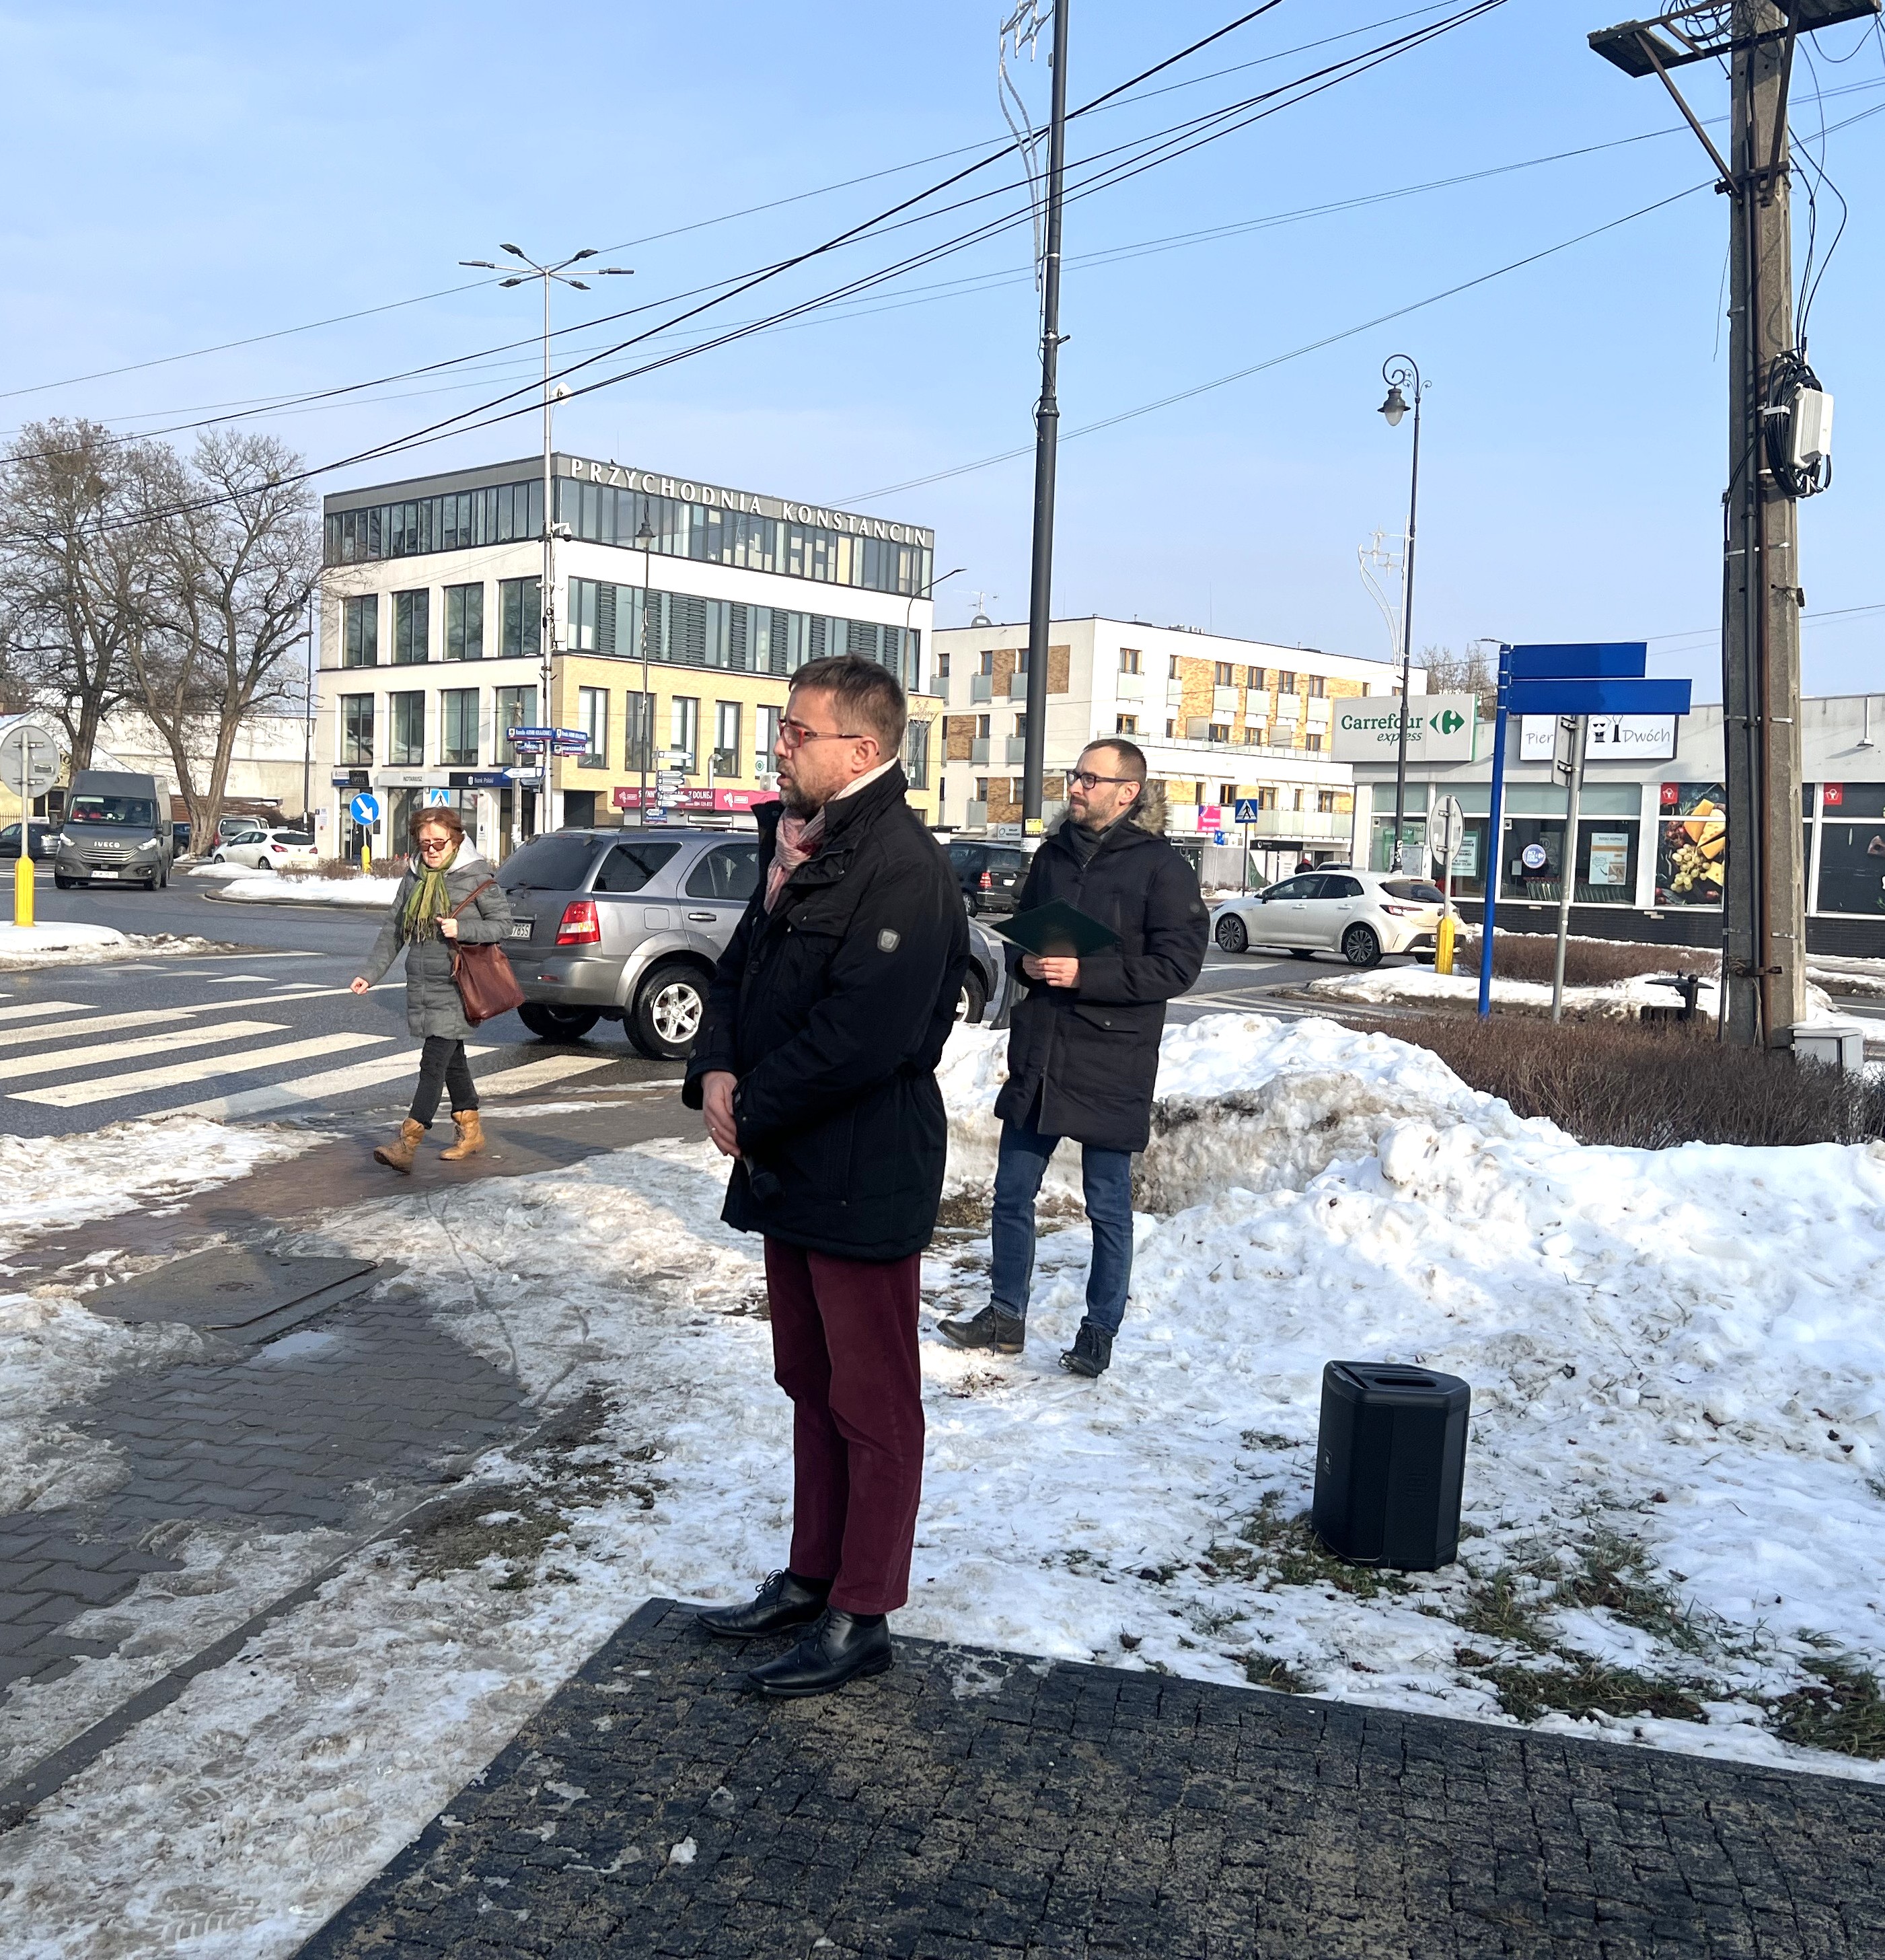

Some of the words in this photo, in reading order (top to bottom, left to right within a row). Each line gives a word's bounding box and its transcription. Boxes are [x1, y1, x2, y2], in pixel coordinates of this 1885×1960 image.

[572, 458, 761, 514] PRZYCHODNIA
[783, 502, 926, 546] KONSTANCIN
[1341, 713, 1423, 730] Carrefour
[1377, 732, 1422, 746] expess
[1623, 728, 1670, 743] Dwóch
